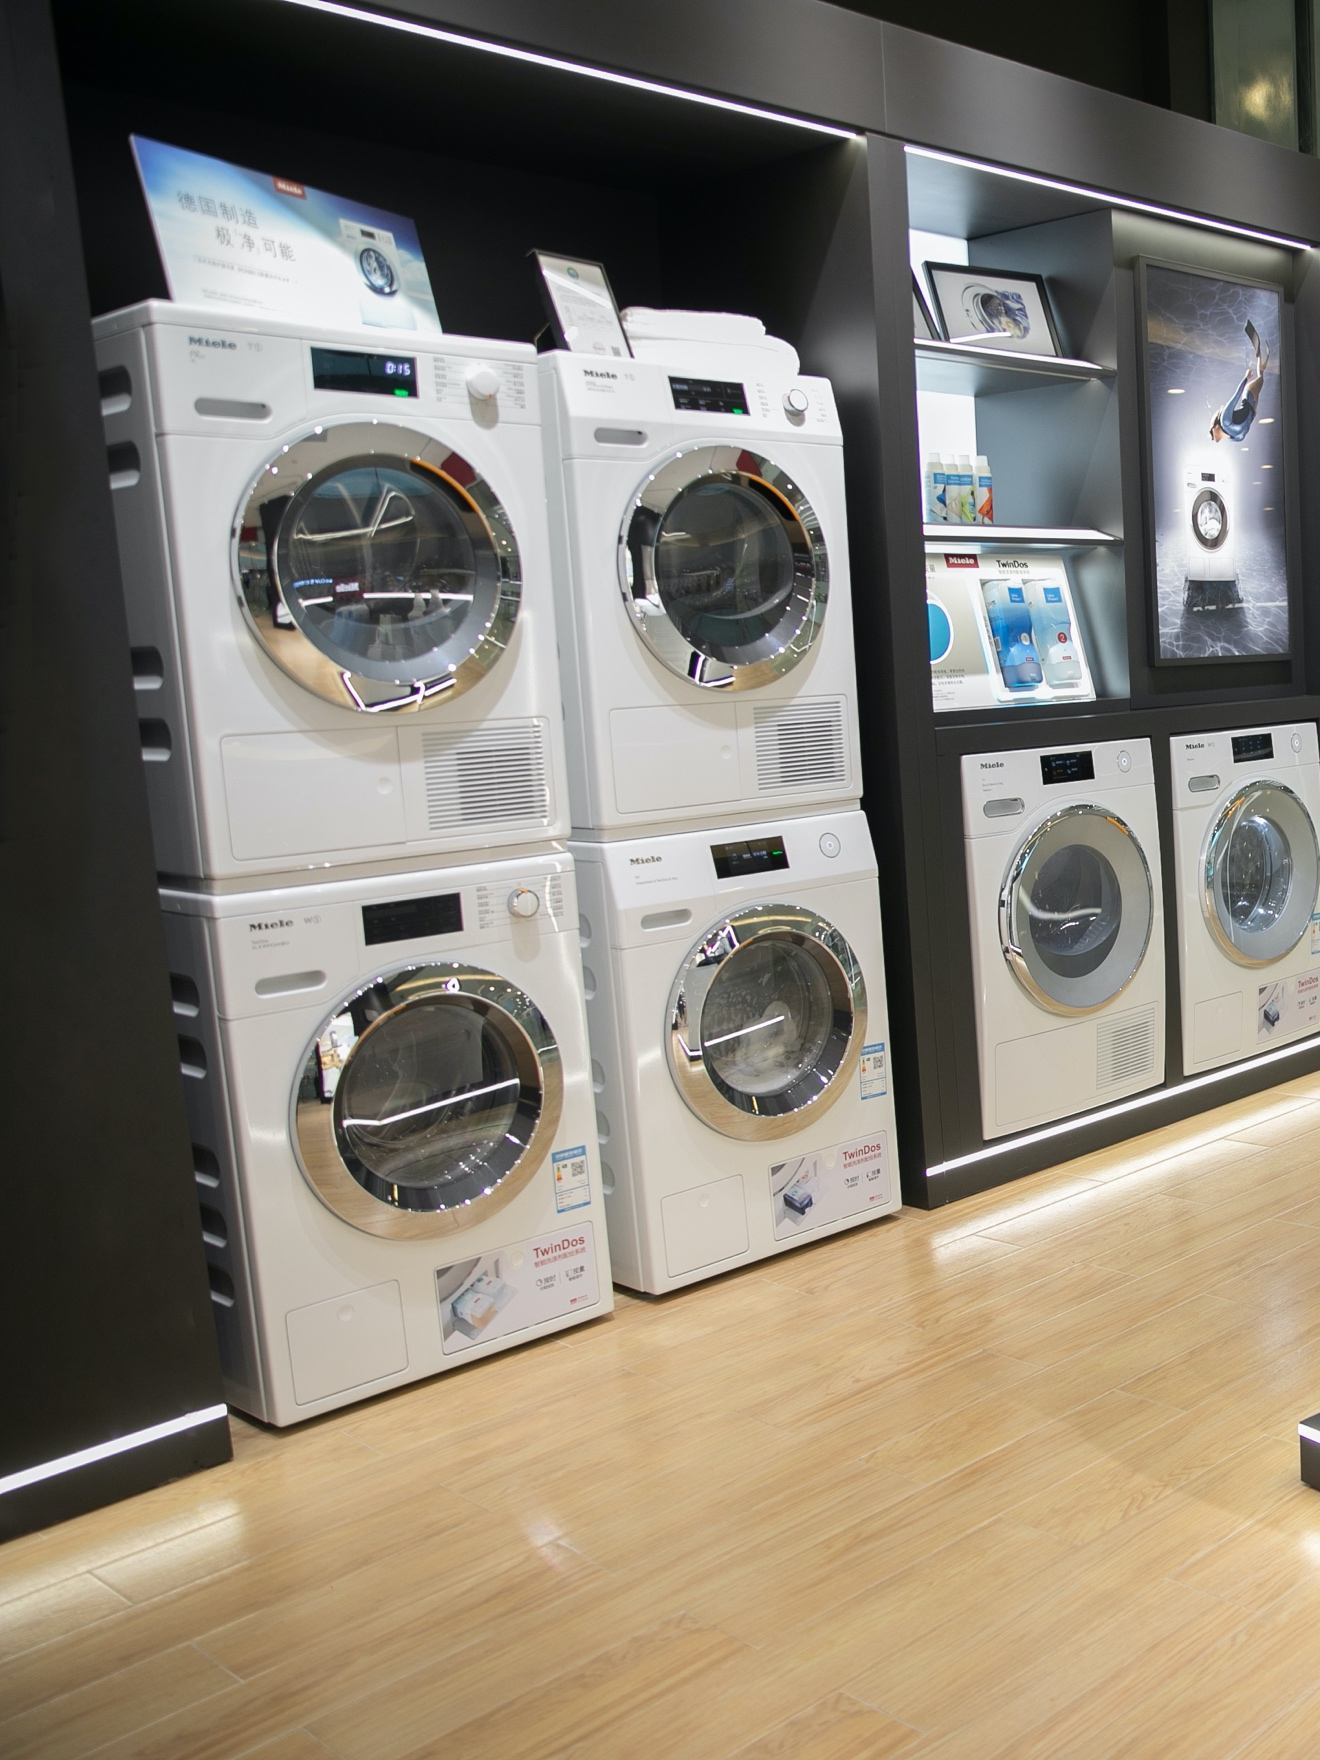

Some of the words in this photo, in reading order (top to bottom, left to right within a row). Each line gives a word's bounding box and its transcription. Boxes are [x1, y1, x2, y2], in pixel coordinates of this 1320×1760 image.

[177, 190, 259, 229] 德国制造
[187, 335, 238, 351] Miele
[583, 369, 619, 380] Miele
[996, 560, 1029, 569] TwinDos
[1184, 742, 1205, 751] Miele
[979, 761, 1005, 770] Miele
[629, 855, 663, 866] Miele
[248, 919, 295, 932] Miele
[842, 1143, 882, 1161] TwinDos
[532, 1236, 586, 1259] TwinDos
